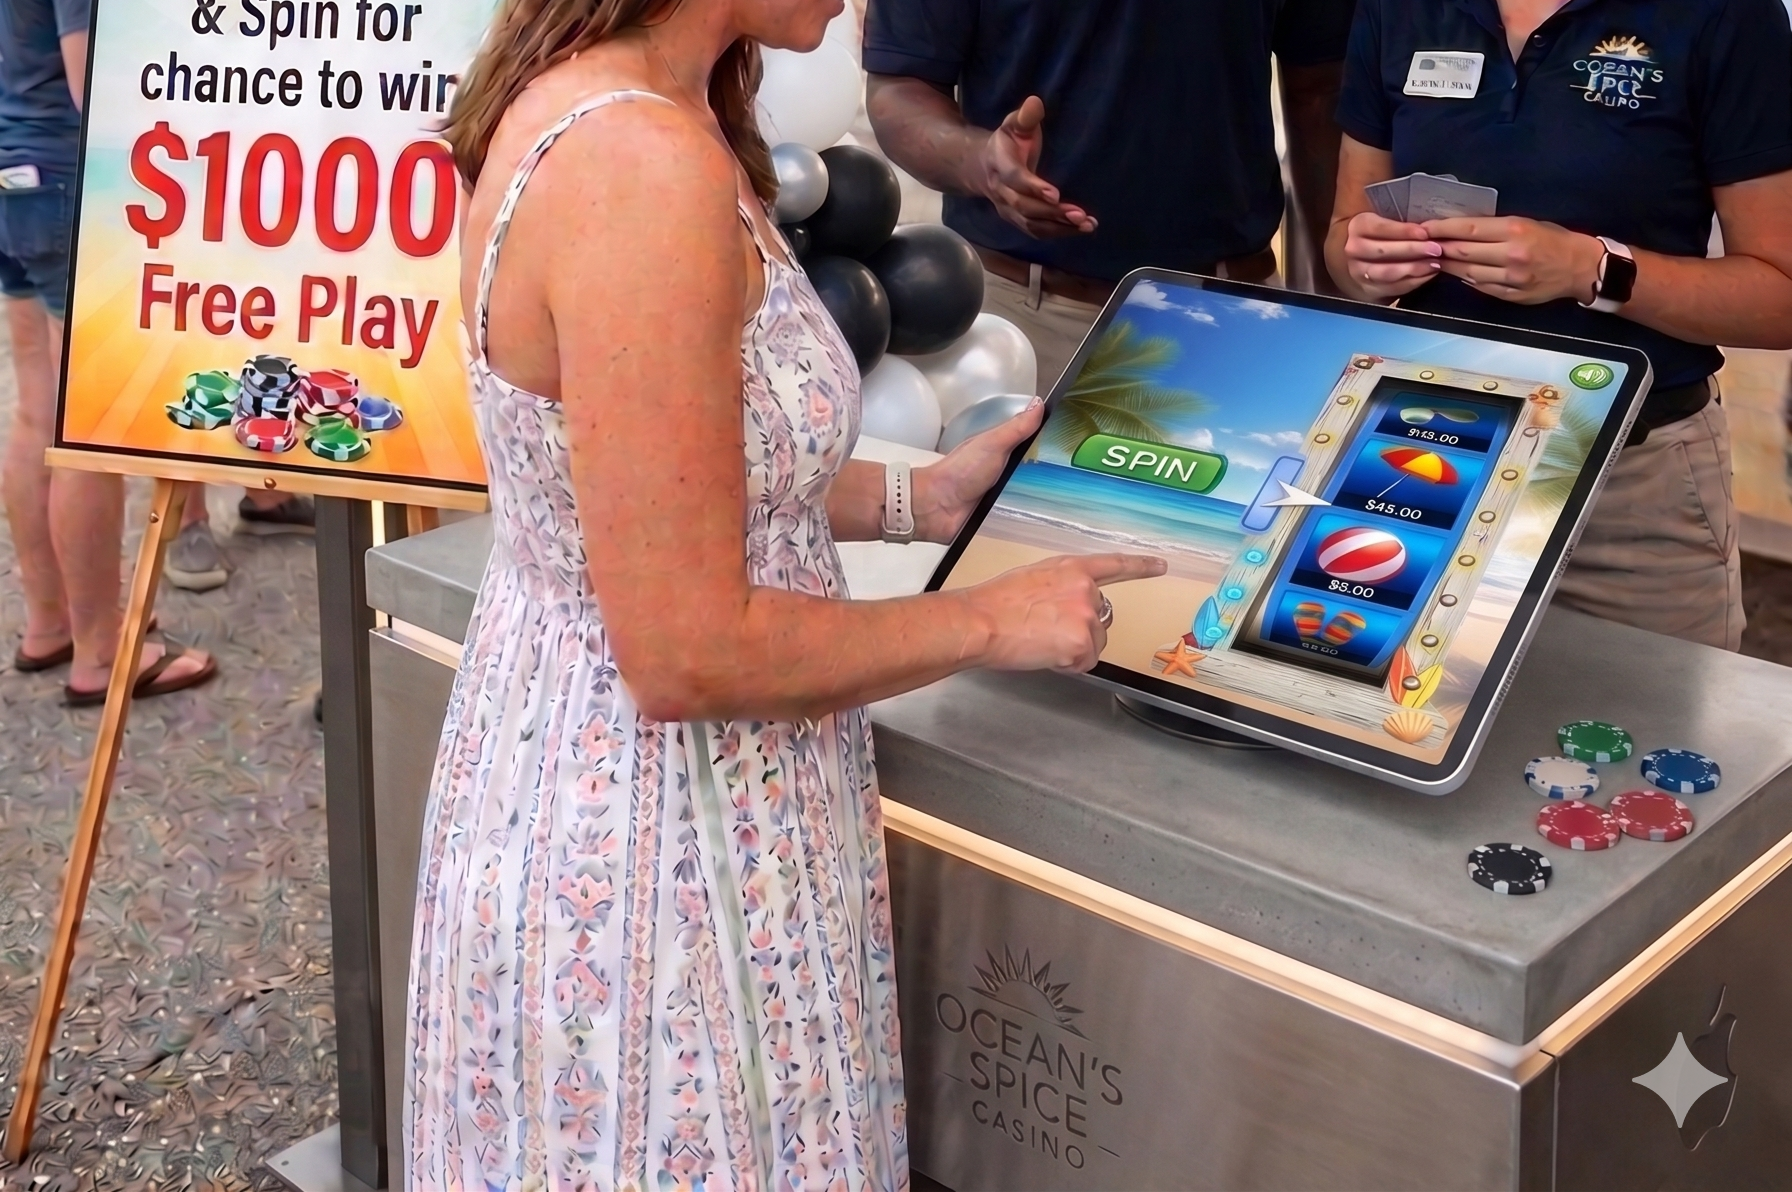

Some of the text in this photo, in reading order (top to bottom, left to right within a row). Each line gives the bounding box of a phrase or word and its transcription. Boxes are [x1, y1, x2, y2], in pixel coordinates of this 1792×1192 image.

[141, 50, 303, 105] chance
[318, 60, 362, 109] to
[126, 121, 455, 257] $1000
[141, 264, 438, 368] Free Play
[1101, 445, 1198, 483] SPIN
[936, 993, 1123, 1106] OCEAN'S
[970, 1051, 1088, 1139] SPICE
[972, 1100, 1085, 1169] CASINO
